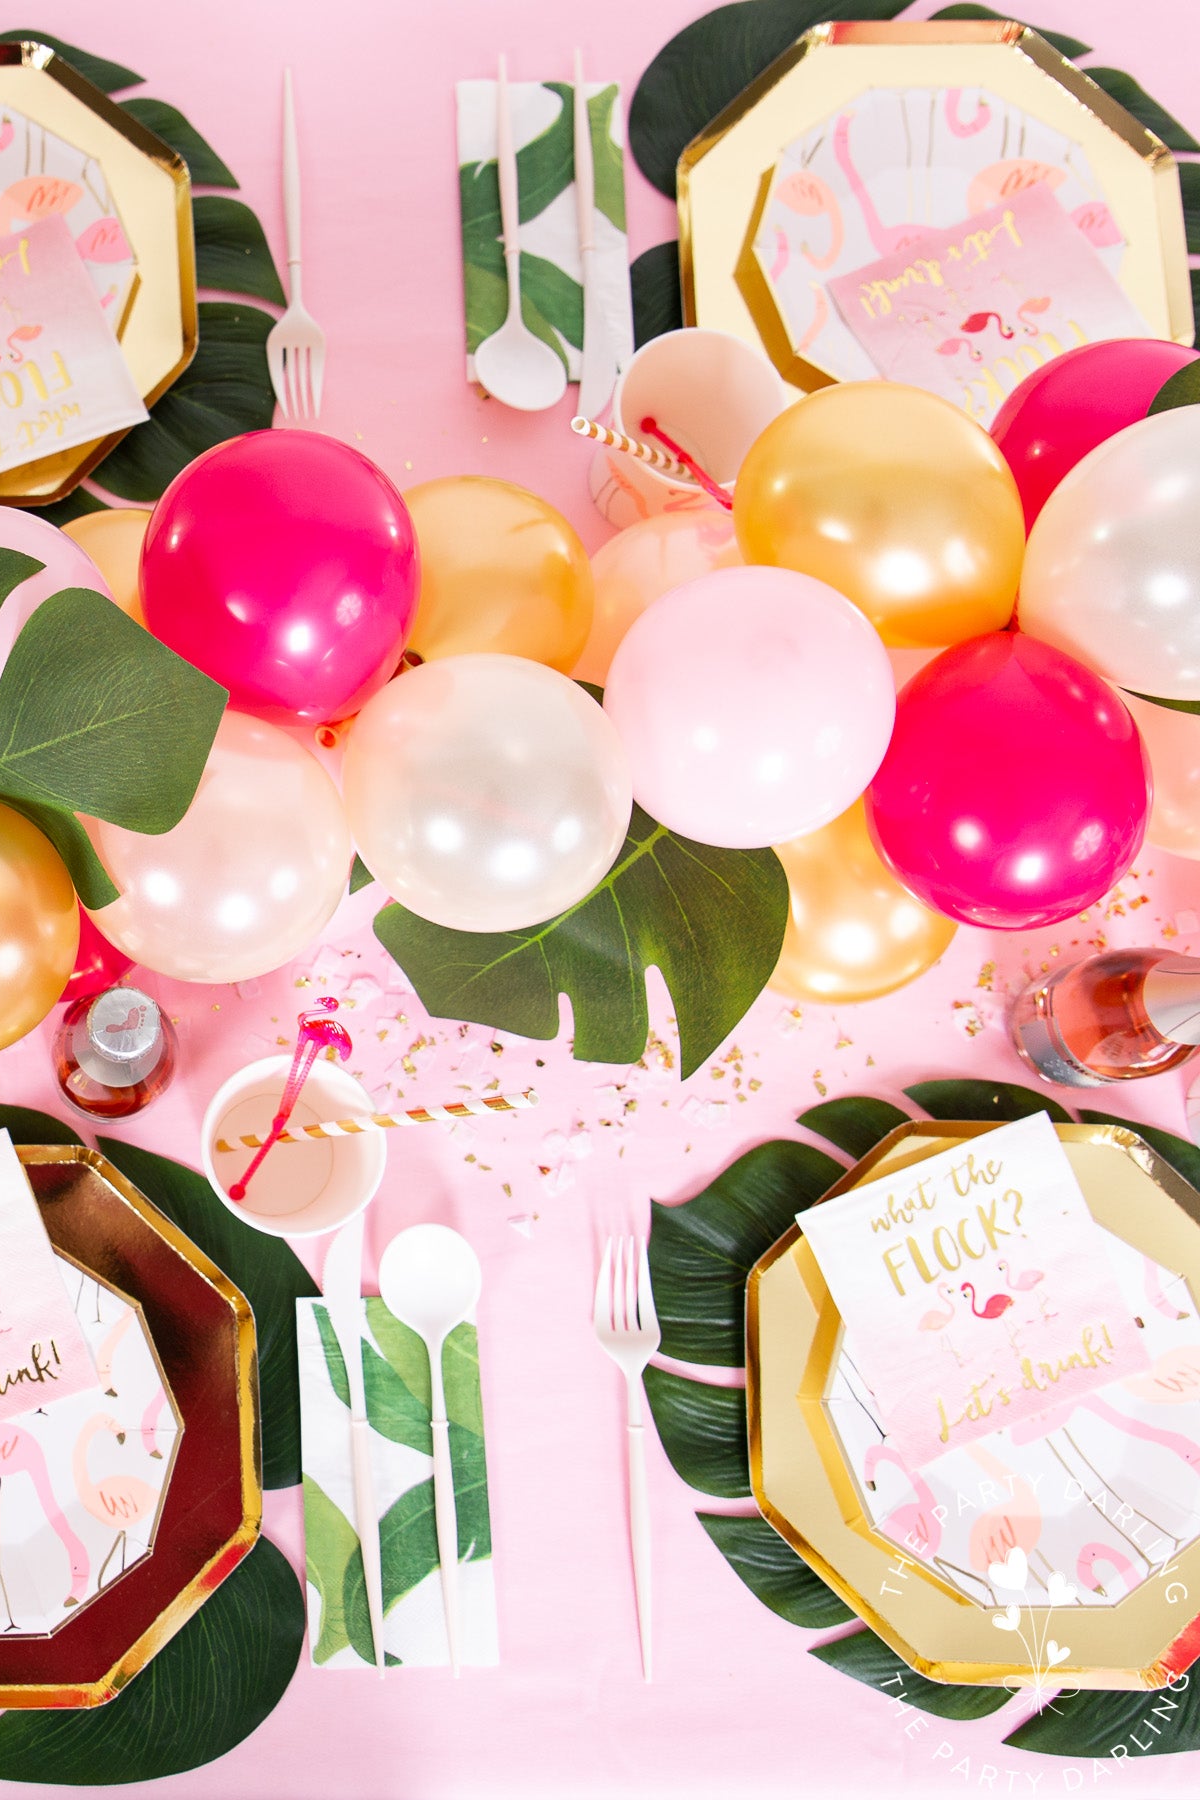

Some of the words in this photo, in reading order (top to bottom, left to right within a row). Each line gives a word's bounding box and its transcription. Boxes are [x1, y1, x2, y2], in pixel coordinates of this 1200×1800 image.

[948, 209, 1023, 272] Let's
[859, 256, 945, 319] drink!
[15, 402, 82, 452] what
[869, 1176, 937, 1234] what
[945, 1153, 1004, 1197] the
[881, 1188, 1028, 1297] FLOCK?
[936, 1373, 1012, 1443] Let's
[1021, 1323, 1115, 1391] drink!
